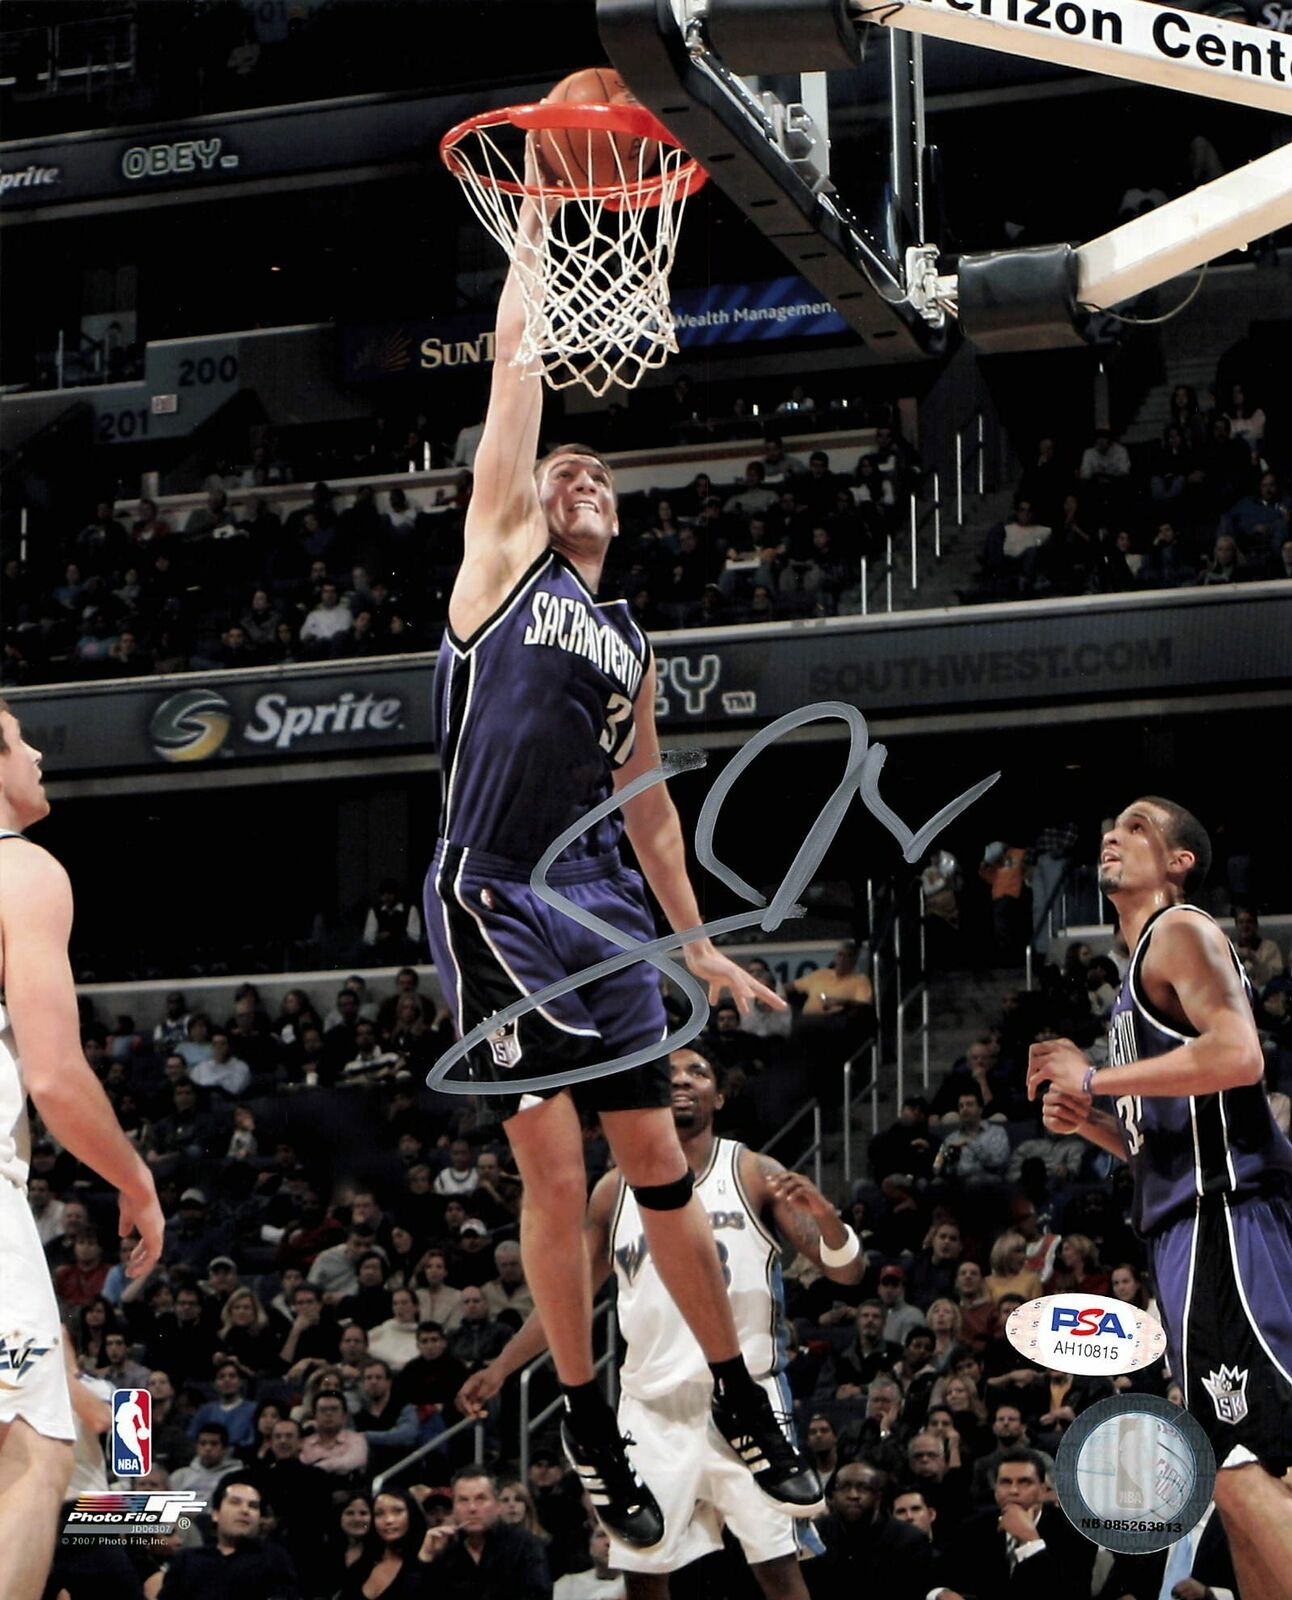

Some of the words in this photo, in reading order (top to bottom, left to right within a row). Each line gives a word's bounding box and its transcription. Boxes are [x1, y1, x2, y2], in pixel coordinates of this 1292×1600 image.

[908, 0, 1123, 45] izon
[1152, 12, 1292, 82] Cent
[122, 138, 222, 179] OBEY
[0, 165, 60, 195] prite
[674, 310, 730, 328] Wealth
[733, 302, 837, 323] Managemen
[178, 354, 238, 387] 200
[100, 410, 149, 441] 201
[523, 591, 643, 701] SACRAMENTO
[809, 637, 1173, 697] SOUTHWEST.COM
[244, 692, 401, 748] Sprite
